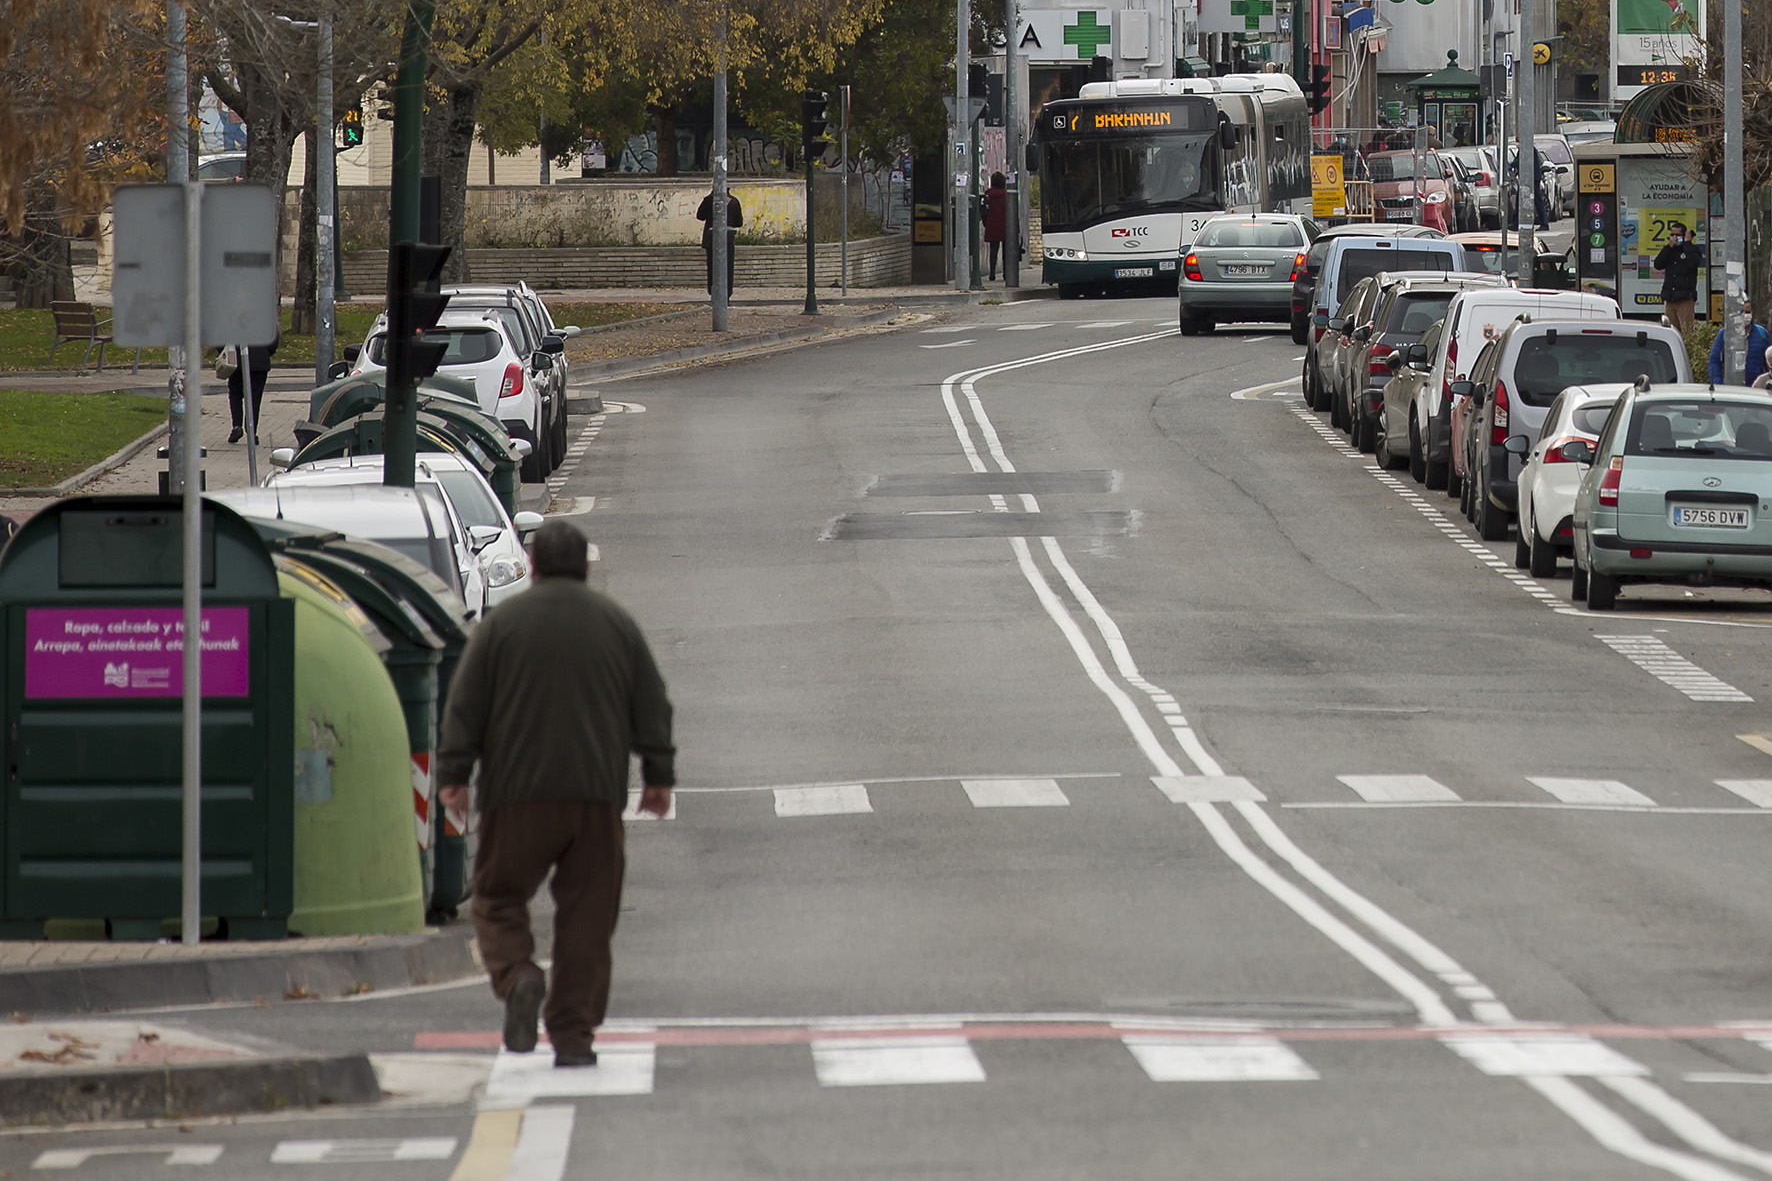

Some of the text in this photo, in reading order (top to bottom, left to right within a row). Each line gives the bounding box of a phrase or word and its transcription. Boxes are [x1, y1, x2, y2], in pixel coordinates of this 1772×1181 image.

[1640, 37, 1651, 48] 15
[1594, 204, 1600, 213] 3
[1594, 219, 1600, 229] 5
[1132, 227, 1148, 236] TCC
[1594, 235, 1600, 245] 7
[1228, 266, 1267, 274] 4796 BTX
[1683, 510, 1745, 524] 5756 DVW
[64, 621, 103, 636] Ropa,
[107, 619, 159, 634] calzado
[163, 622, 172, 635] y
[34, 639, 83, 654] Arropa,
